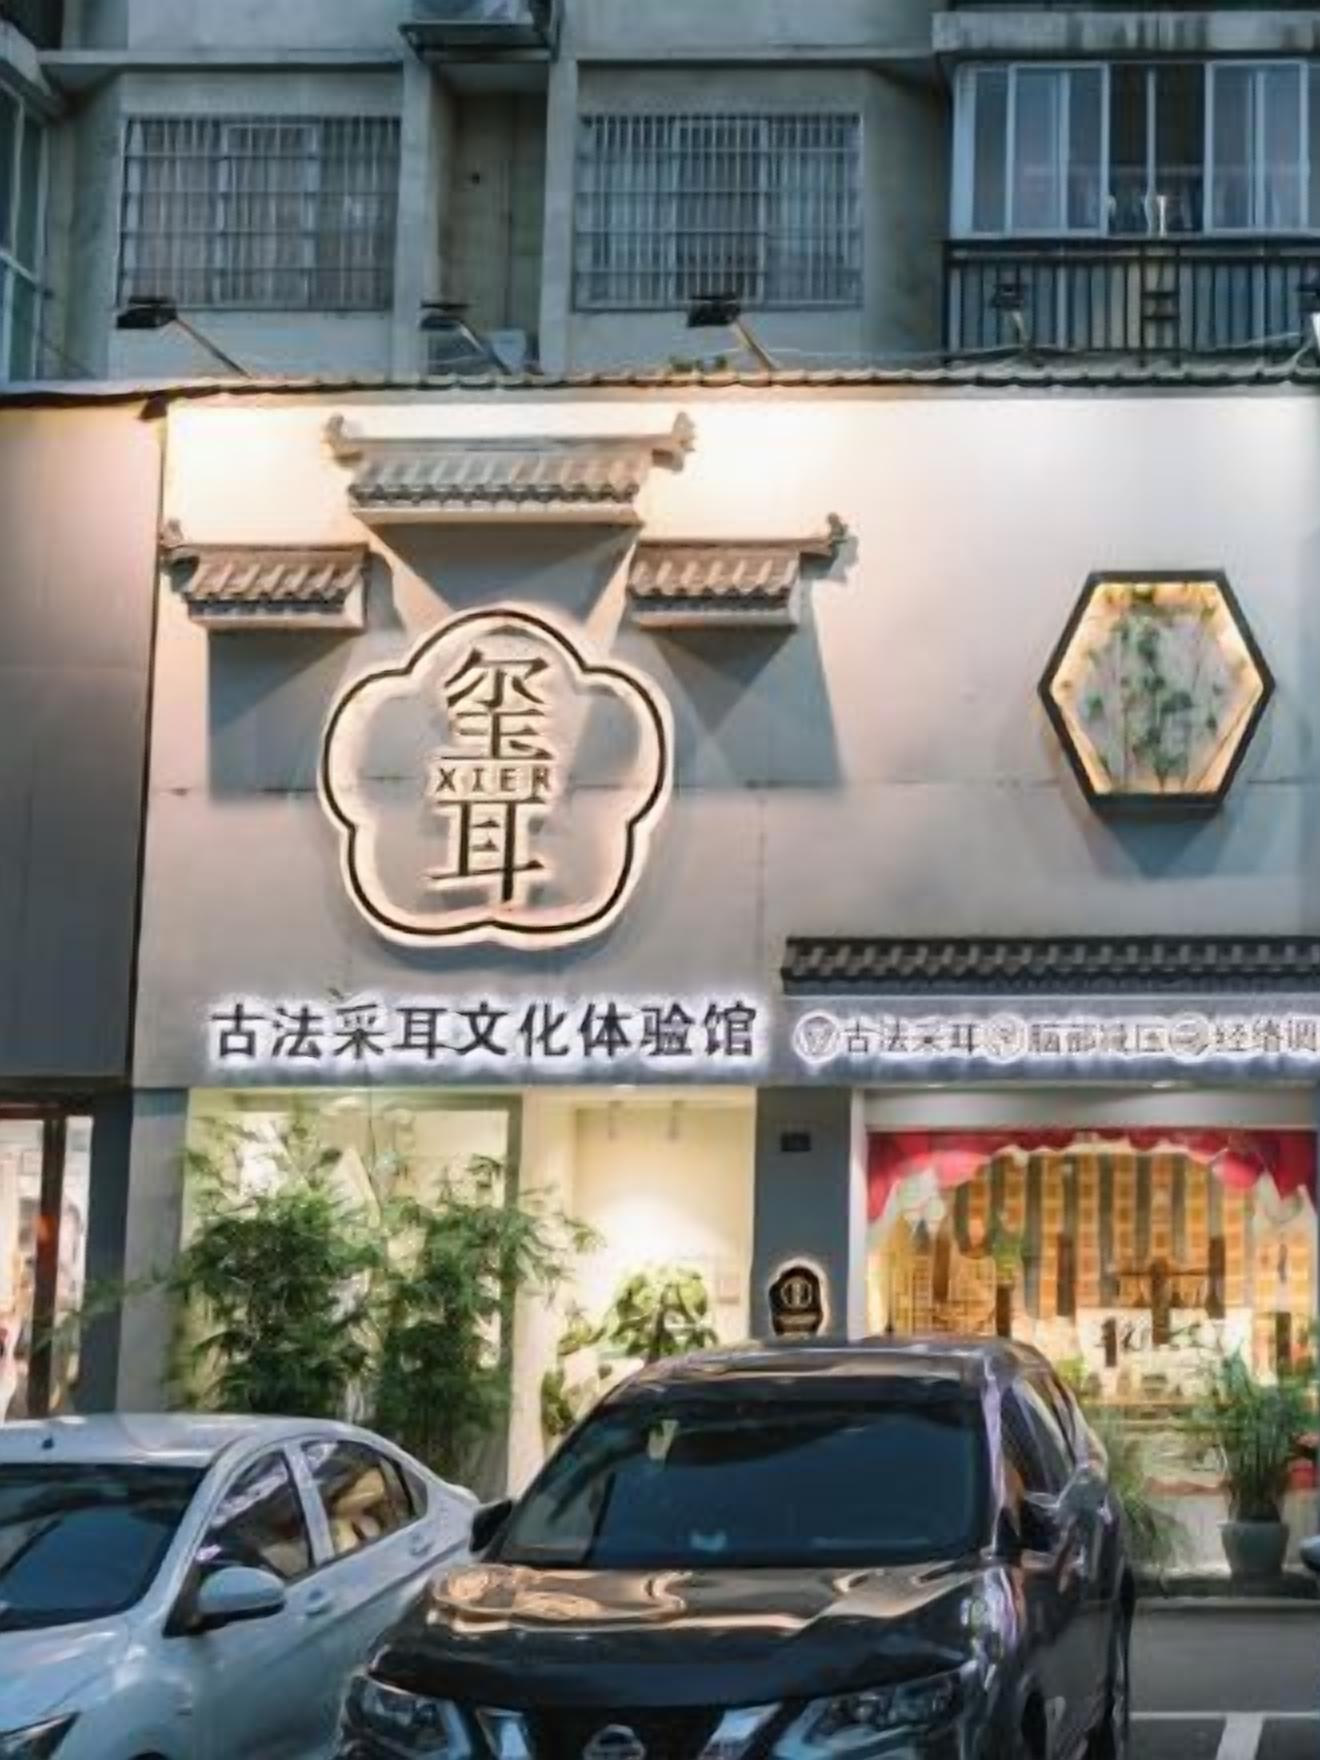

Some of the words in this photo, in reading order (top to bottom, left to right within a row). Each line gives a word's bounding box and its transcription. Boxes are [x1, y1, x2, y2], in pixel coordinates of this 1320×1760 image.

[211, 1001, 757, 1060] 古法采耳文化体验馆
